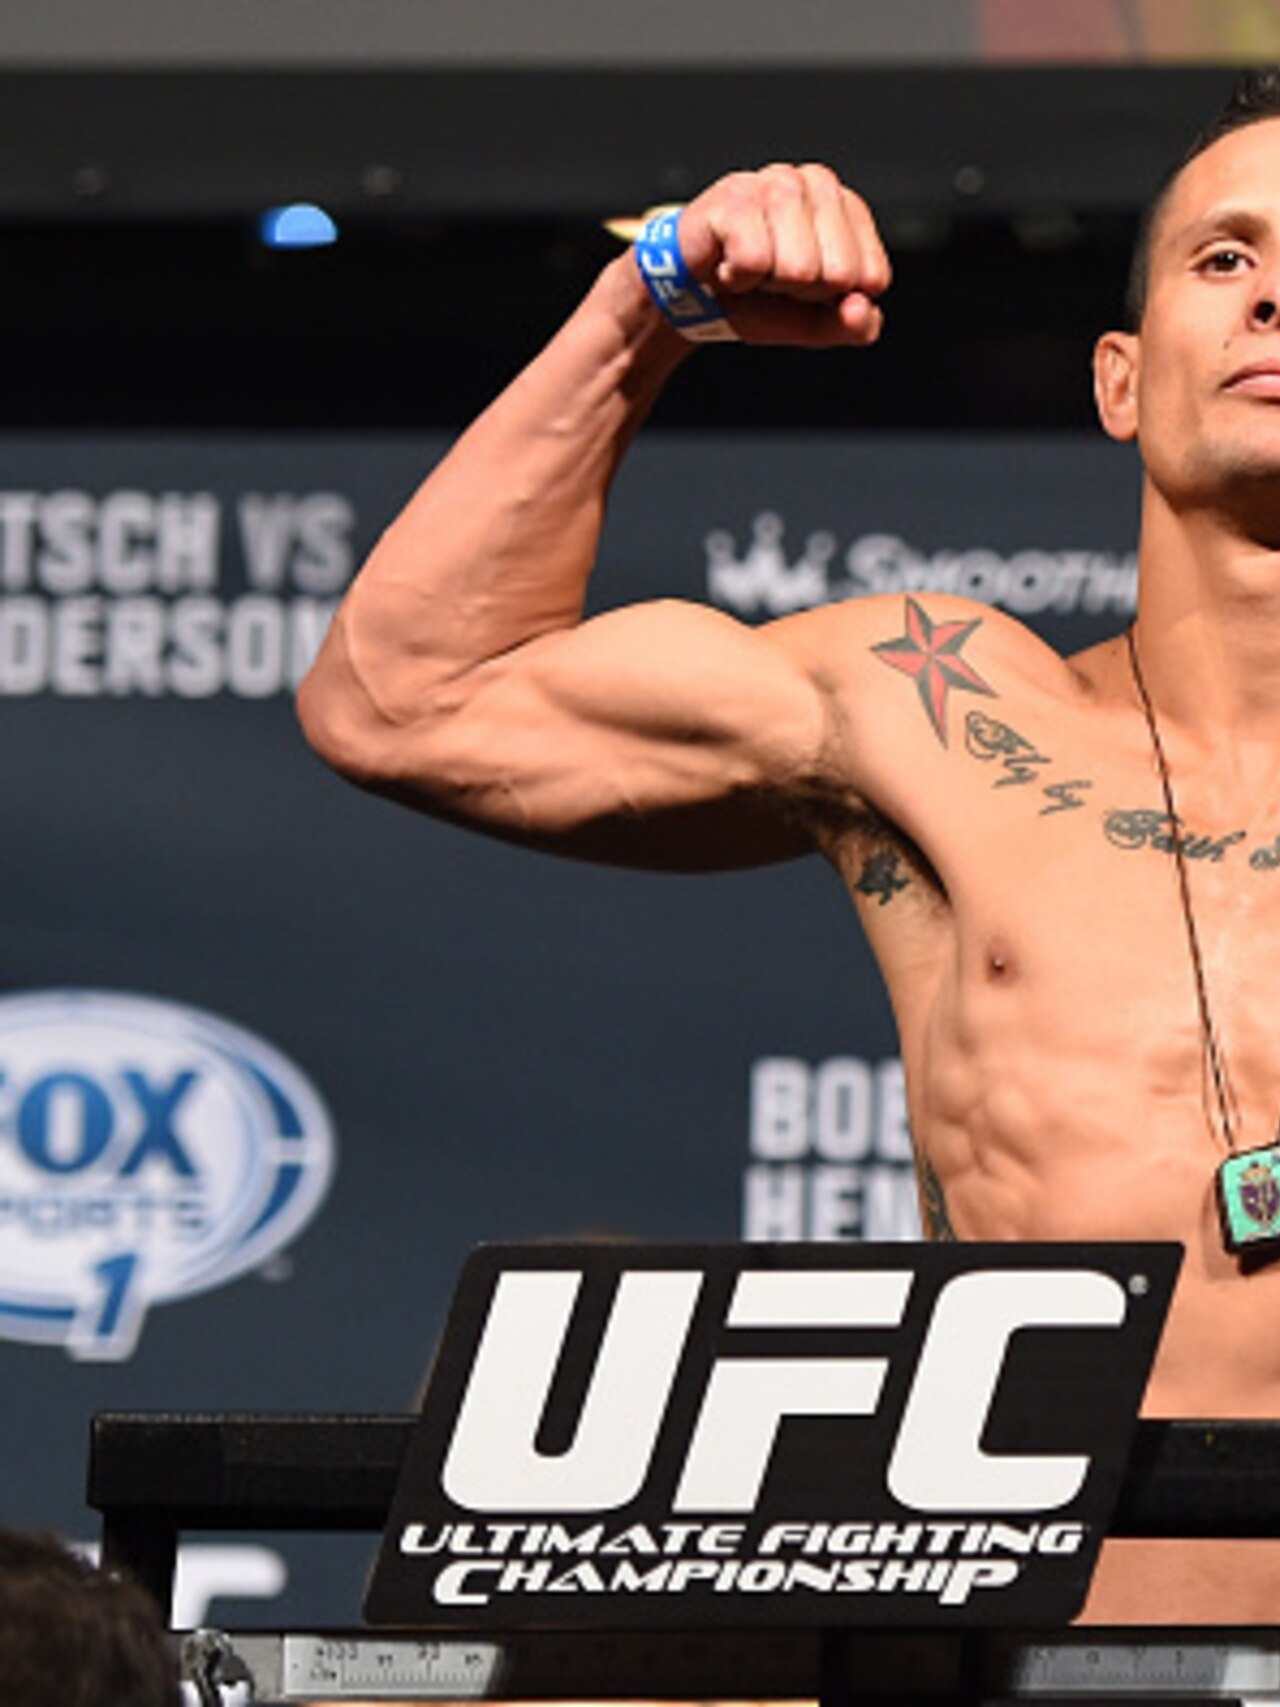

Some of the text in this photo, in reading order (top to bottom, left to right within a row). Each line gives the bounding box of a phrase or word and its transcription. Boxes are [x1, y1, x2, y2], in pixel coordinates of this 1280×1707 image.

[237, 490, 351, 594] VS
[0, 1071, 198, 1179] OX
[440, 1269, 1128, 1513] UFC
[399, 1523, 1086, 1557] ULTIMATE FIGHTING
[433, 1560, 1019, 1605] CHAMPIONSHIP
